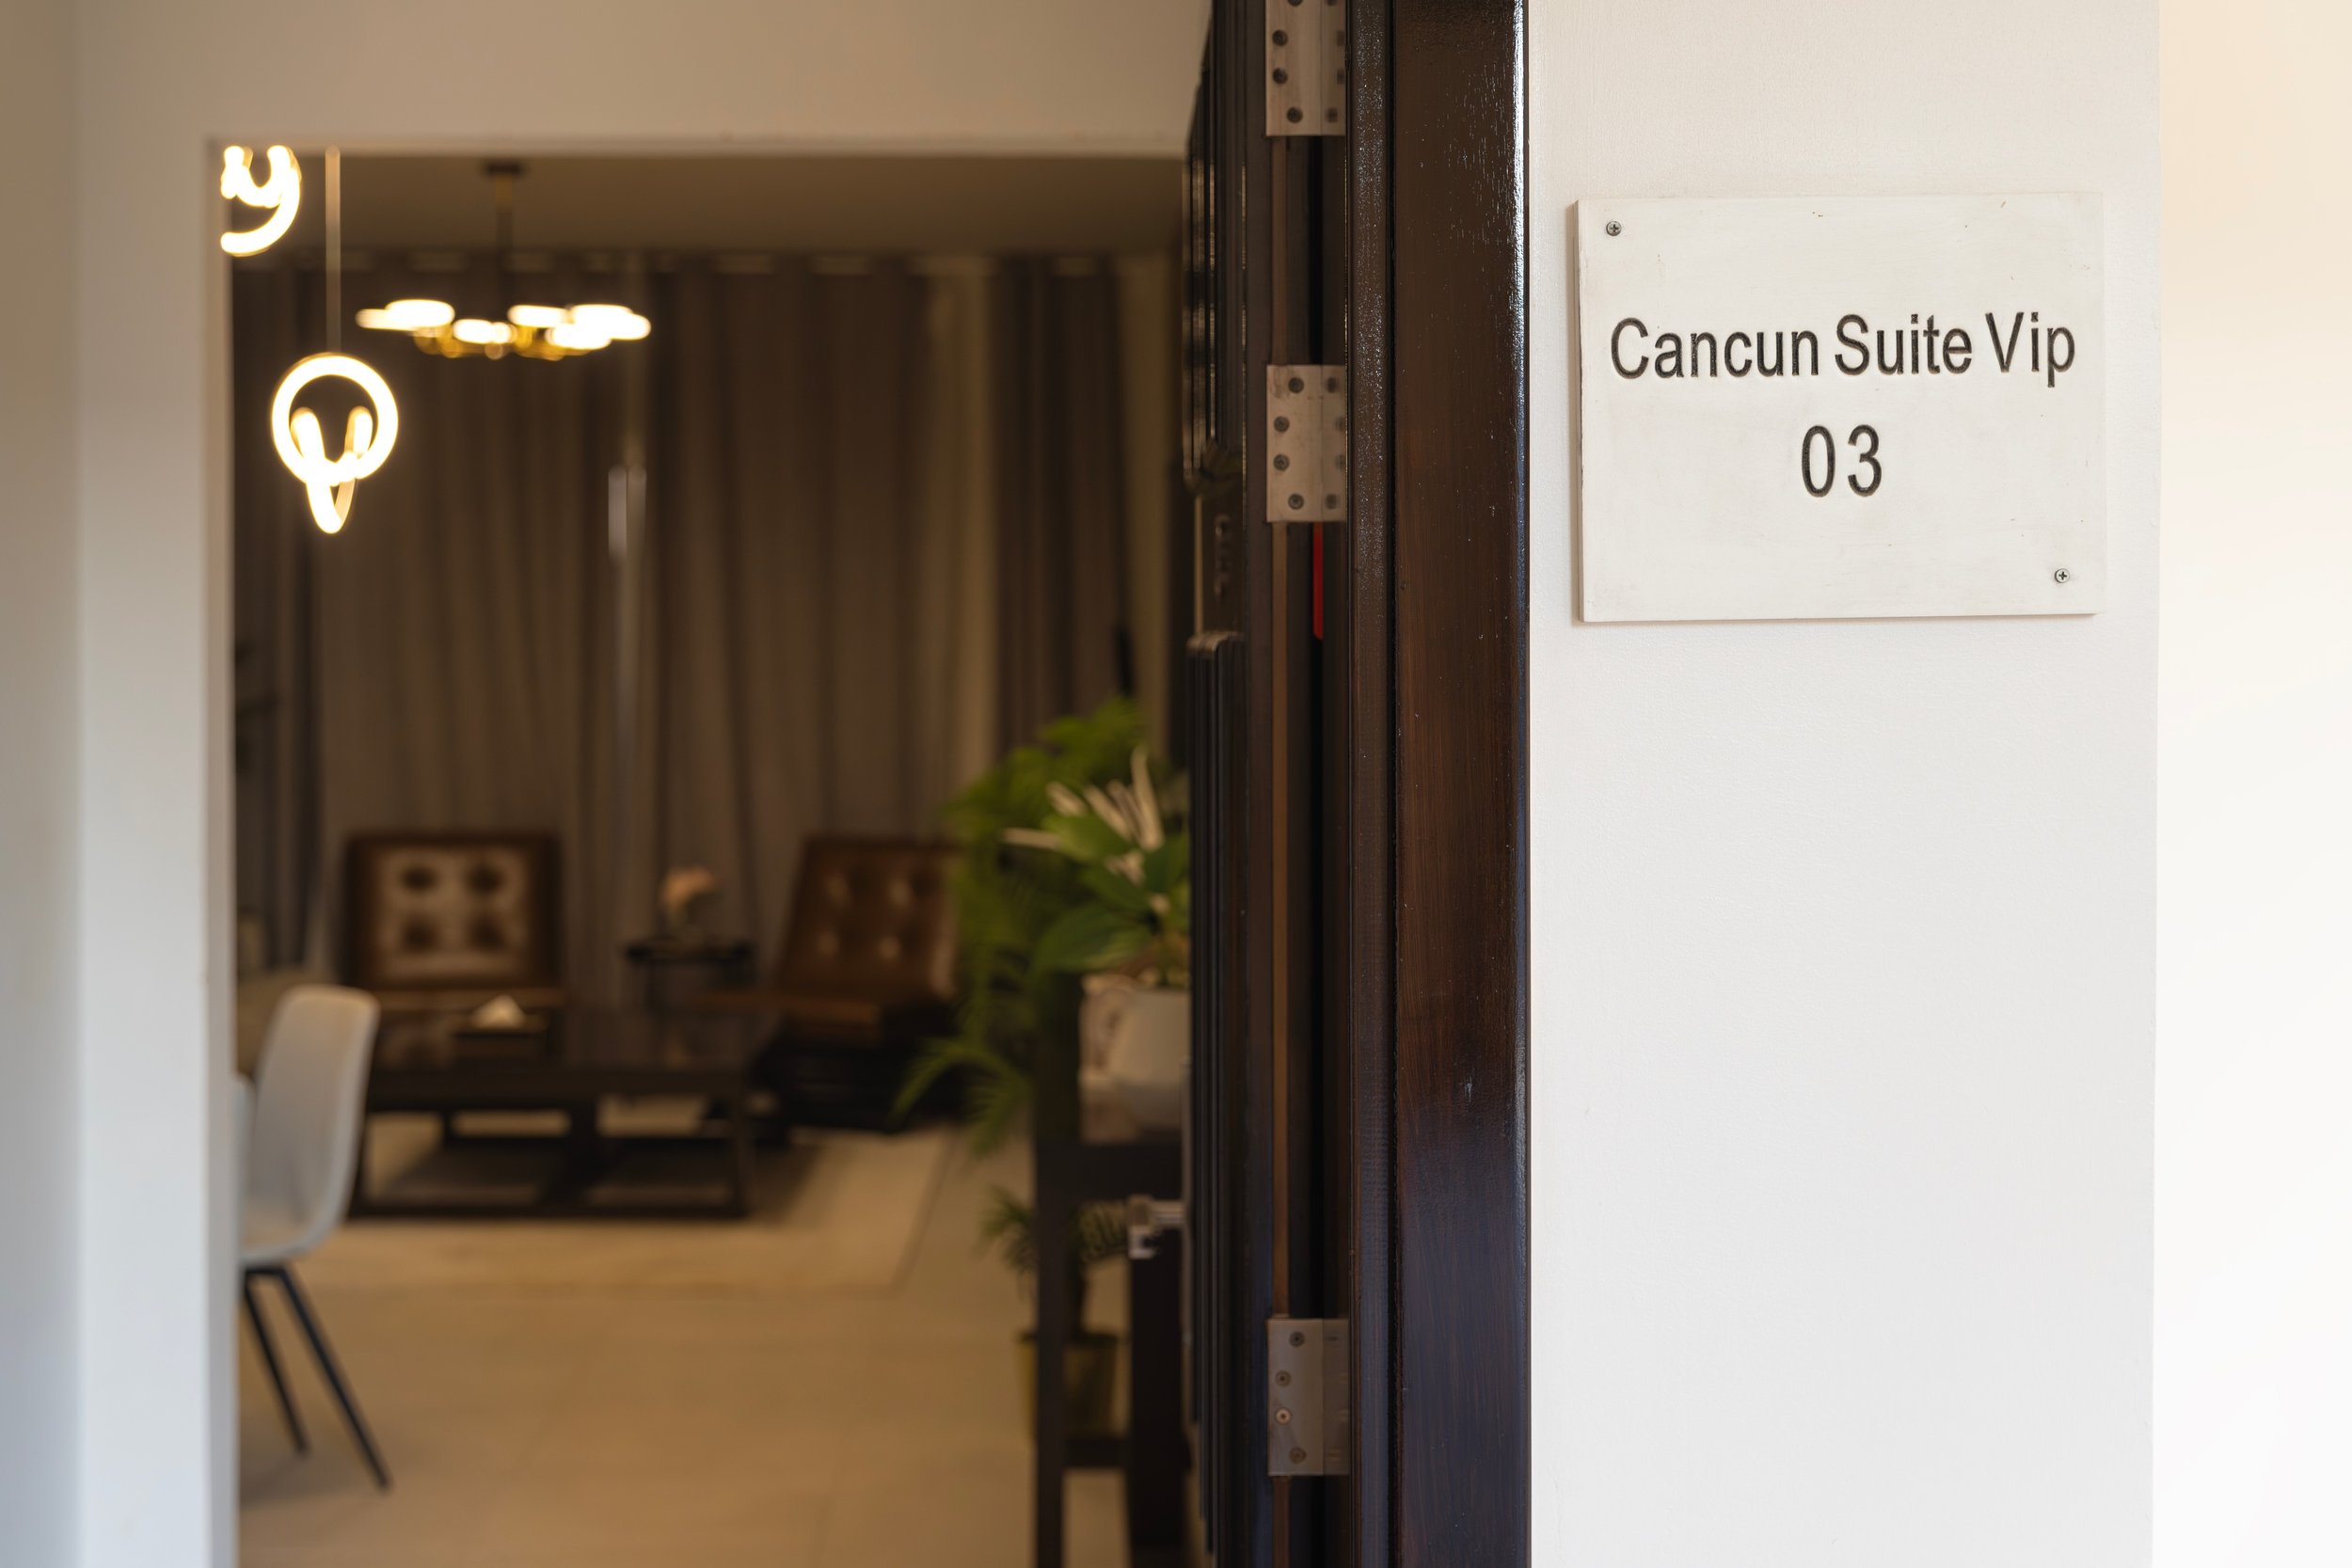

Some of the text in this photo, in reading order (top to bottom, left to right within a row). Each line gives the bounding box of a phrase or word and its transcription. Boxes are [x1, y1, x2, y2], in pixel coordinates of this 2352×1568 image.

[1610, 310, 2076, 389] Cancun Suite Vip
[1800, 423, 1883, 499] 03
